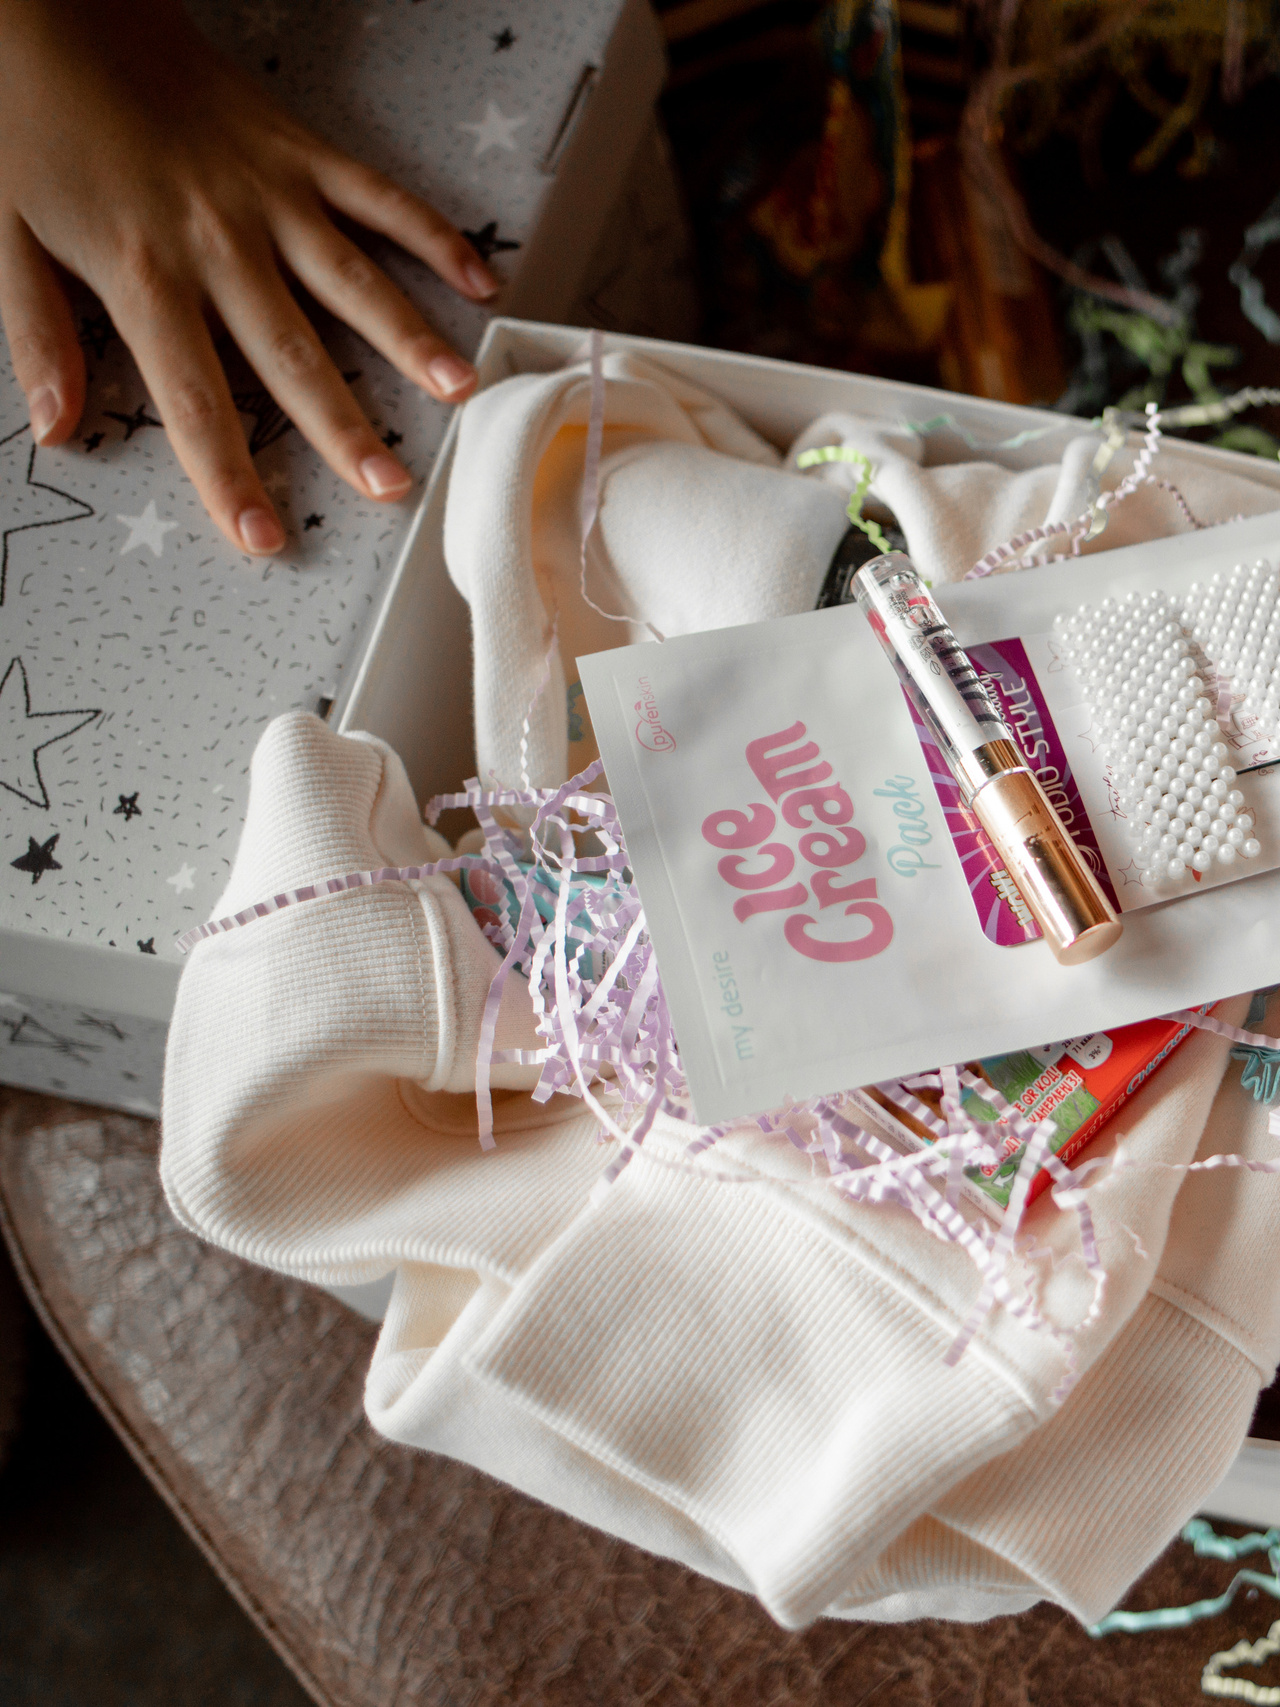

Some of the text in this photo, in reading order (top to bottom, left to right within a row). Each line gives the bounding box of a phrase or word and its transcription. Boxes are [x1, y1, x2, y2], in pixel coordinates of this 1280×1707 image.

[637, 675, 670, 747] purenskin
[979, 669, 1015, 737] eauty
[1000, 675, 1050, 760] STYLE
[700, 802, 809, 925] Ice
[744, 720, 894, 964] Cream
[872, 774, 943, 878] Pack
[711, 949, 755, 1062] my desire
[1021, 1065, 1062, 1107] QR КОД!
[1026, 1071, 1081, 1124] КАНЕРЛЕҢІЗ!
